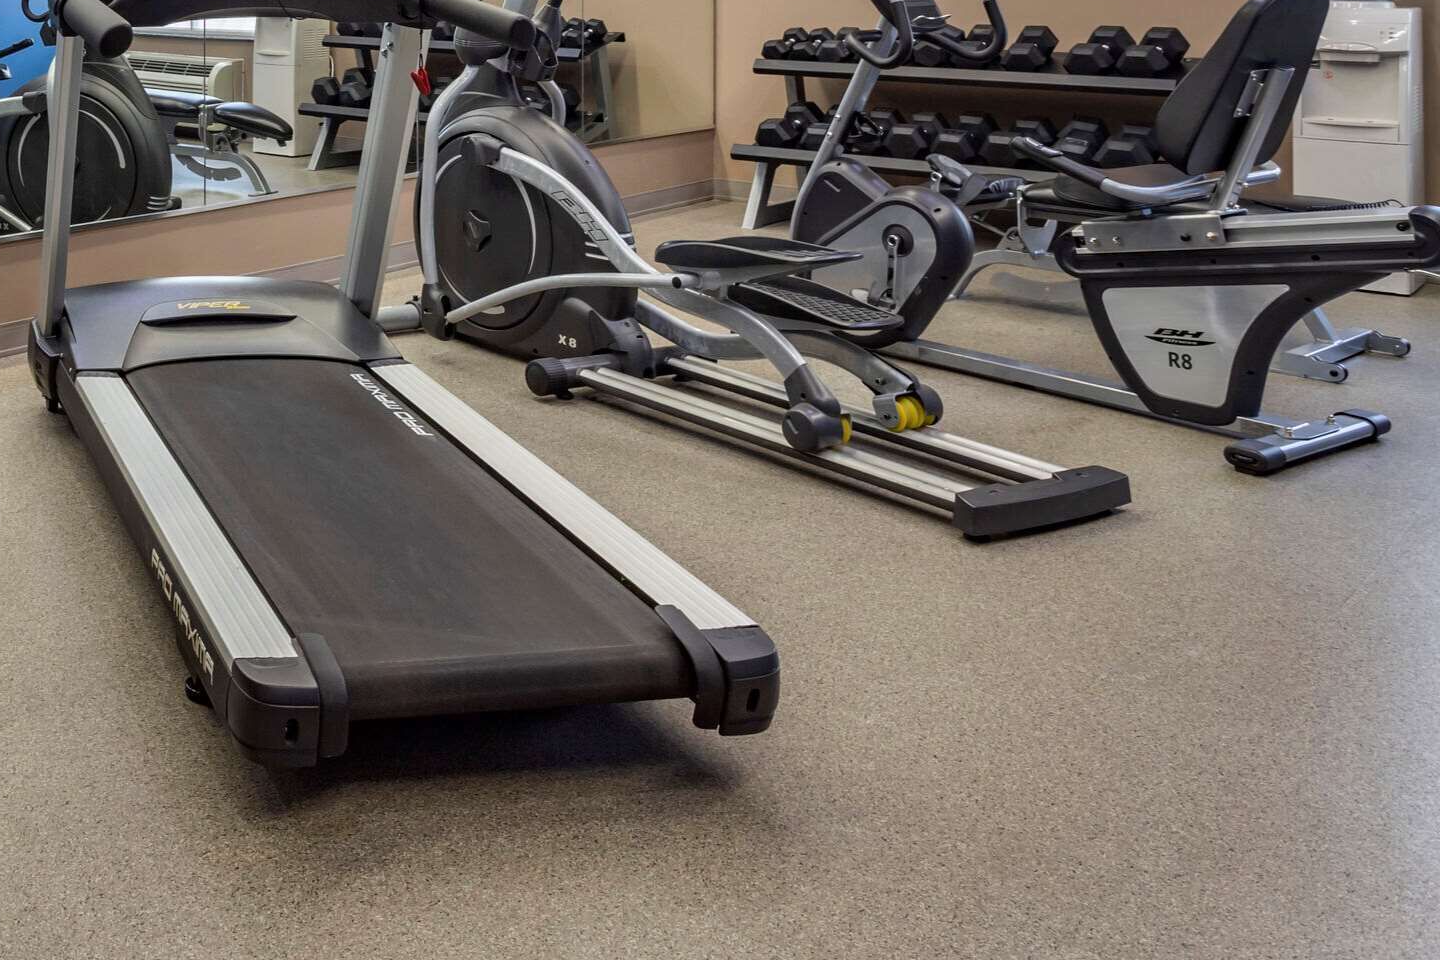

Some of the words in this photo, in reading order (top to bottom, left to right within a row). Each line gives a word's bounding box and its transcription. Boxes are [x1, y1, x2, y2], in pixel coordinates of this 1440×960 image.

[176, 300, 241, 310] VIPER
[1152, 327, 1205, 339] BH
[1168, 351, 1193, 370] R8
[349, 373, 403, 411] MAXIMA
[393, 411, 435, 436] PRO
[151, 548, 173, 601] PRO
[172, 591, 214, 686] MAXIMA
